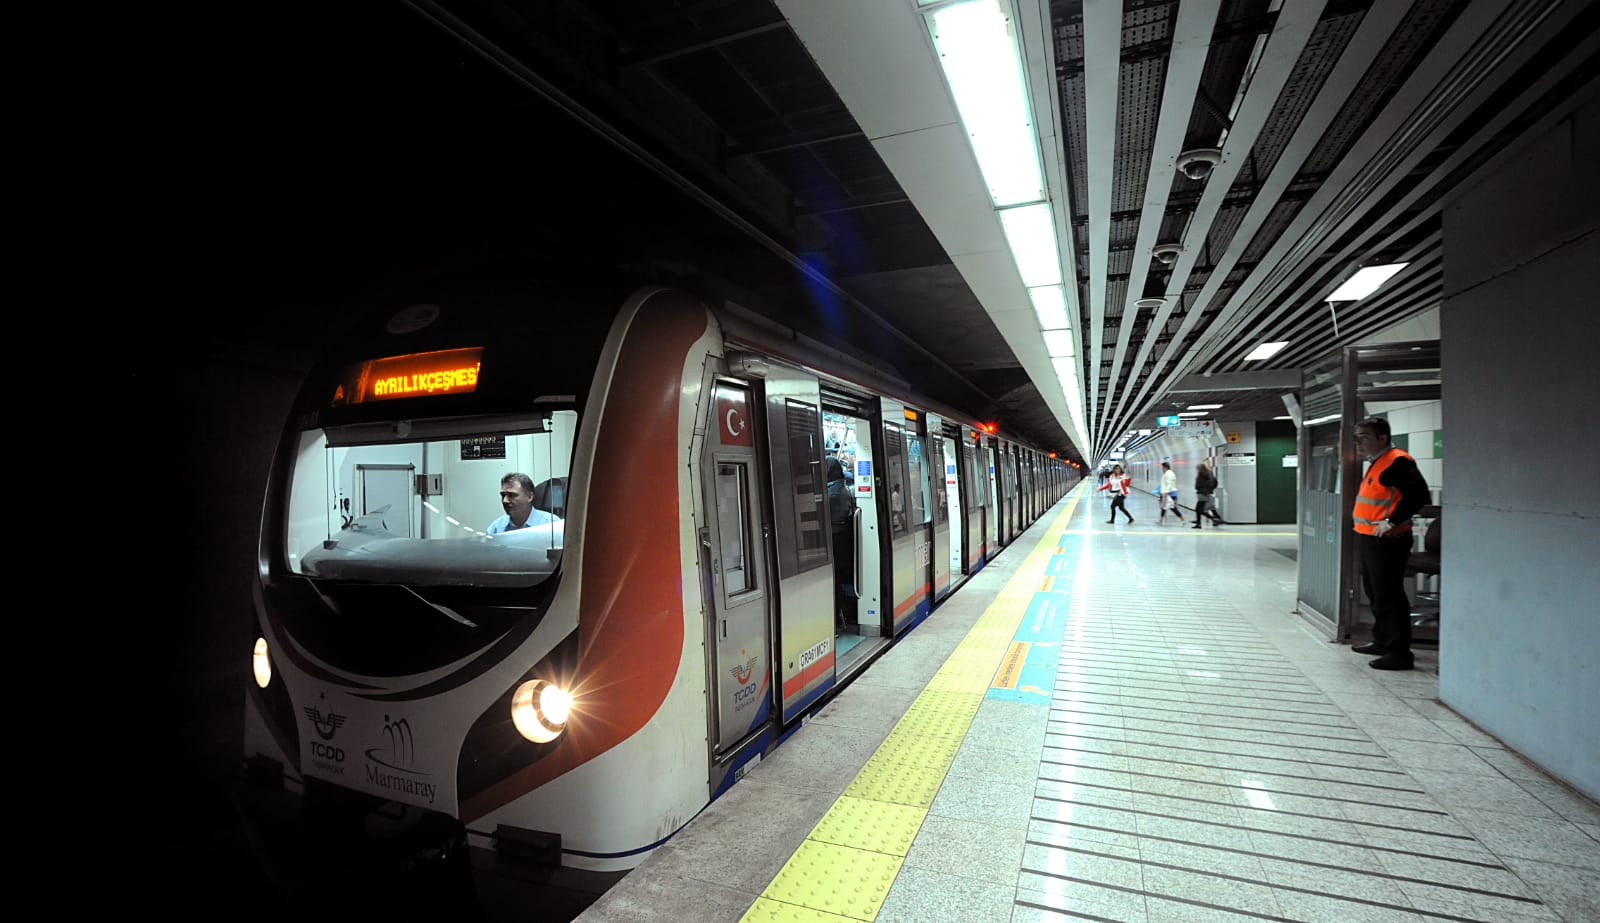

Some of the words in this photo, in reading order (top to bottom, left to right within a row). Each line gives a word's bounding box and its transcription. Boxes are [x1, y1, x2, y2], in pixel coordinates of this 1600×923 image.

[734, 682, 757, 705] TCDD
[310, 741, 345, 762] TCDD
[365, 764, 437, 804] Marmaray
